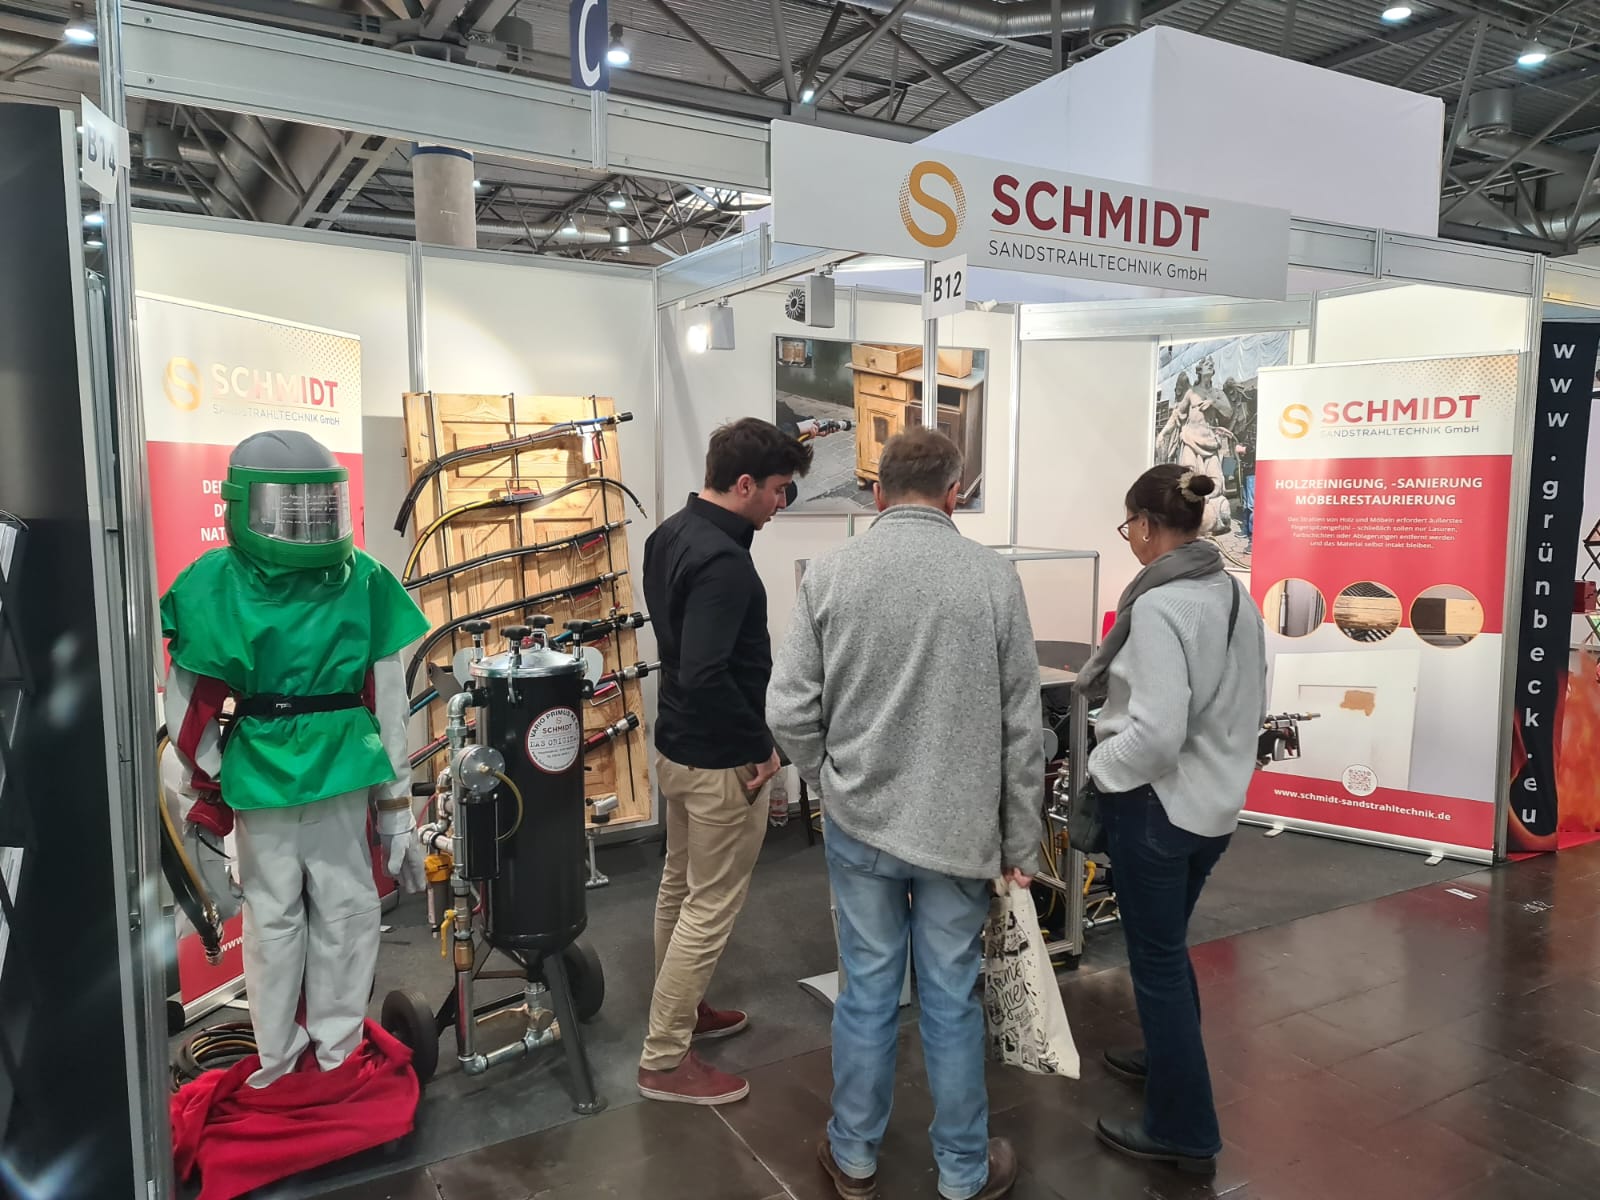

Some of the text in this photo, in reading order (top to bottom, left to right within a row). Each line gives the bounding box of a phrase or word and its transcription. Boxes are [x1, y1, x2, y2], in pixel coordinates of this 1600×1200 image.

[578, 0, 600, 87] C
[991, 174, 1210, 252] SCHMIDT
[988, 240, 1208, 282] SANDSTRAHLTECHNIK GmbH
[933, 271, 962, 302] B12
[211, 362, 338, 408] SCHMIDT
[1321, 394, 1481, 424] SCHMIDT
[1321, 424, 1480, 439] ANDSTRAHLTECHNIK GmbH
[1274, 477, 1483, 491] HOLZREINIGUNG, -SANIERUNG
[1295, 492, 1456, 506] MÖBELRESTAURIERUNG
[542, 723, 572, 734] SCHMIDT
[1274, 787, 1451, 821] www.schmidt-sandstrahltechnik.de
